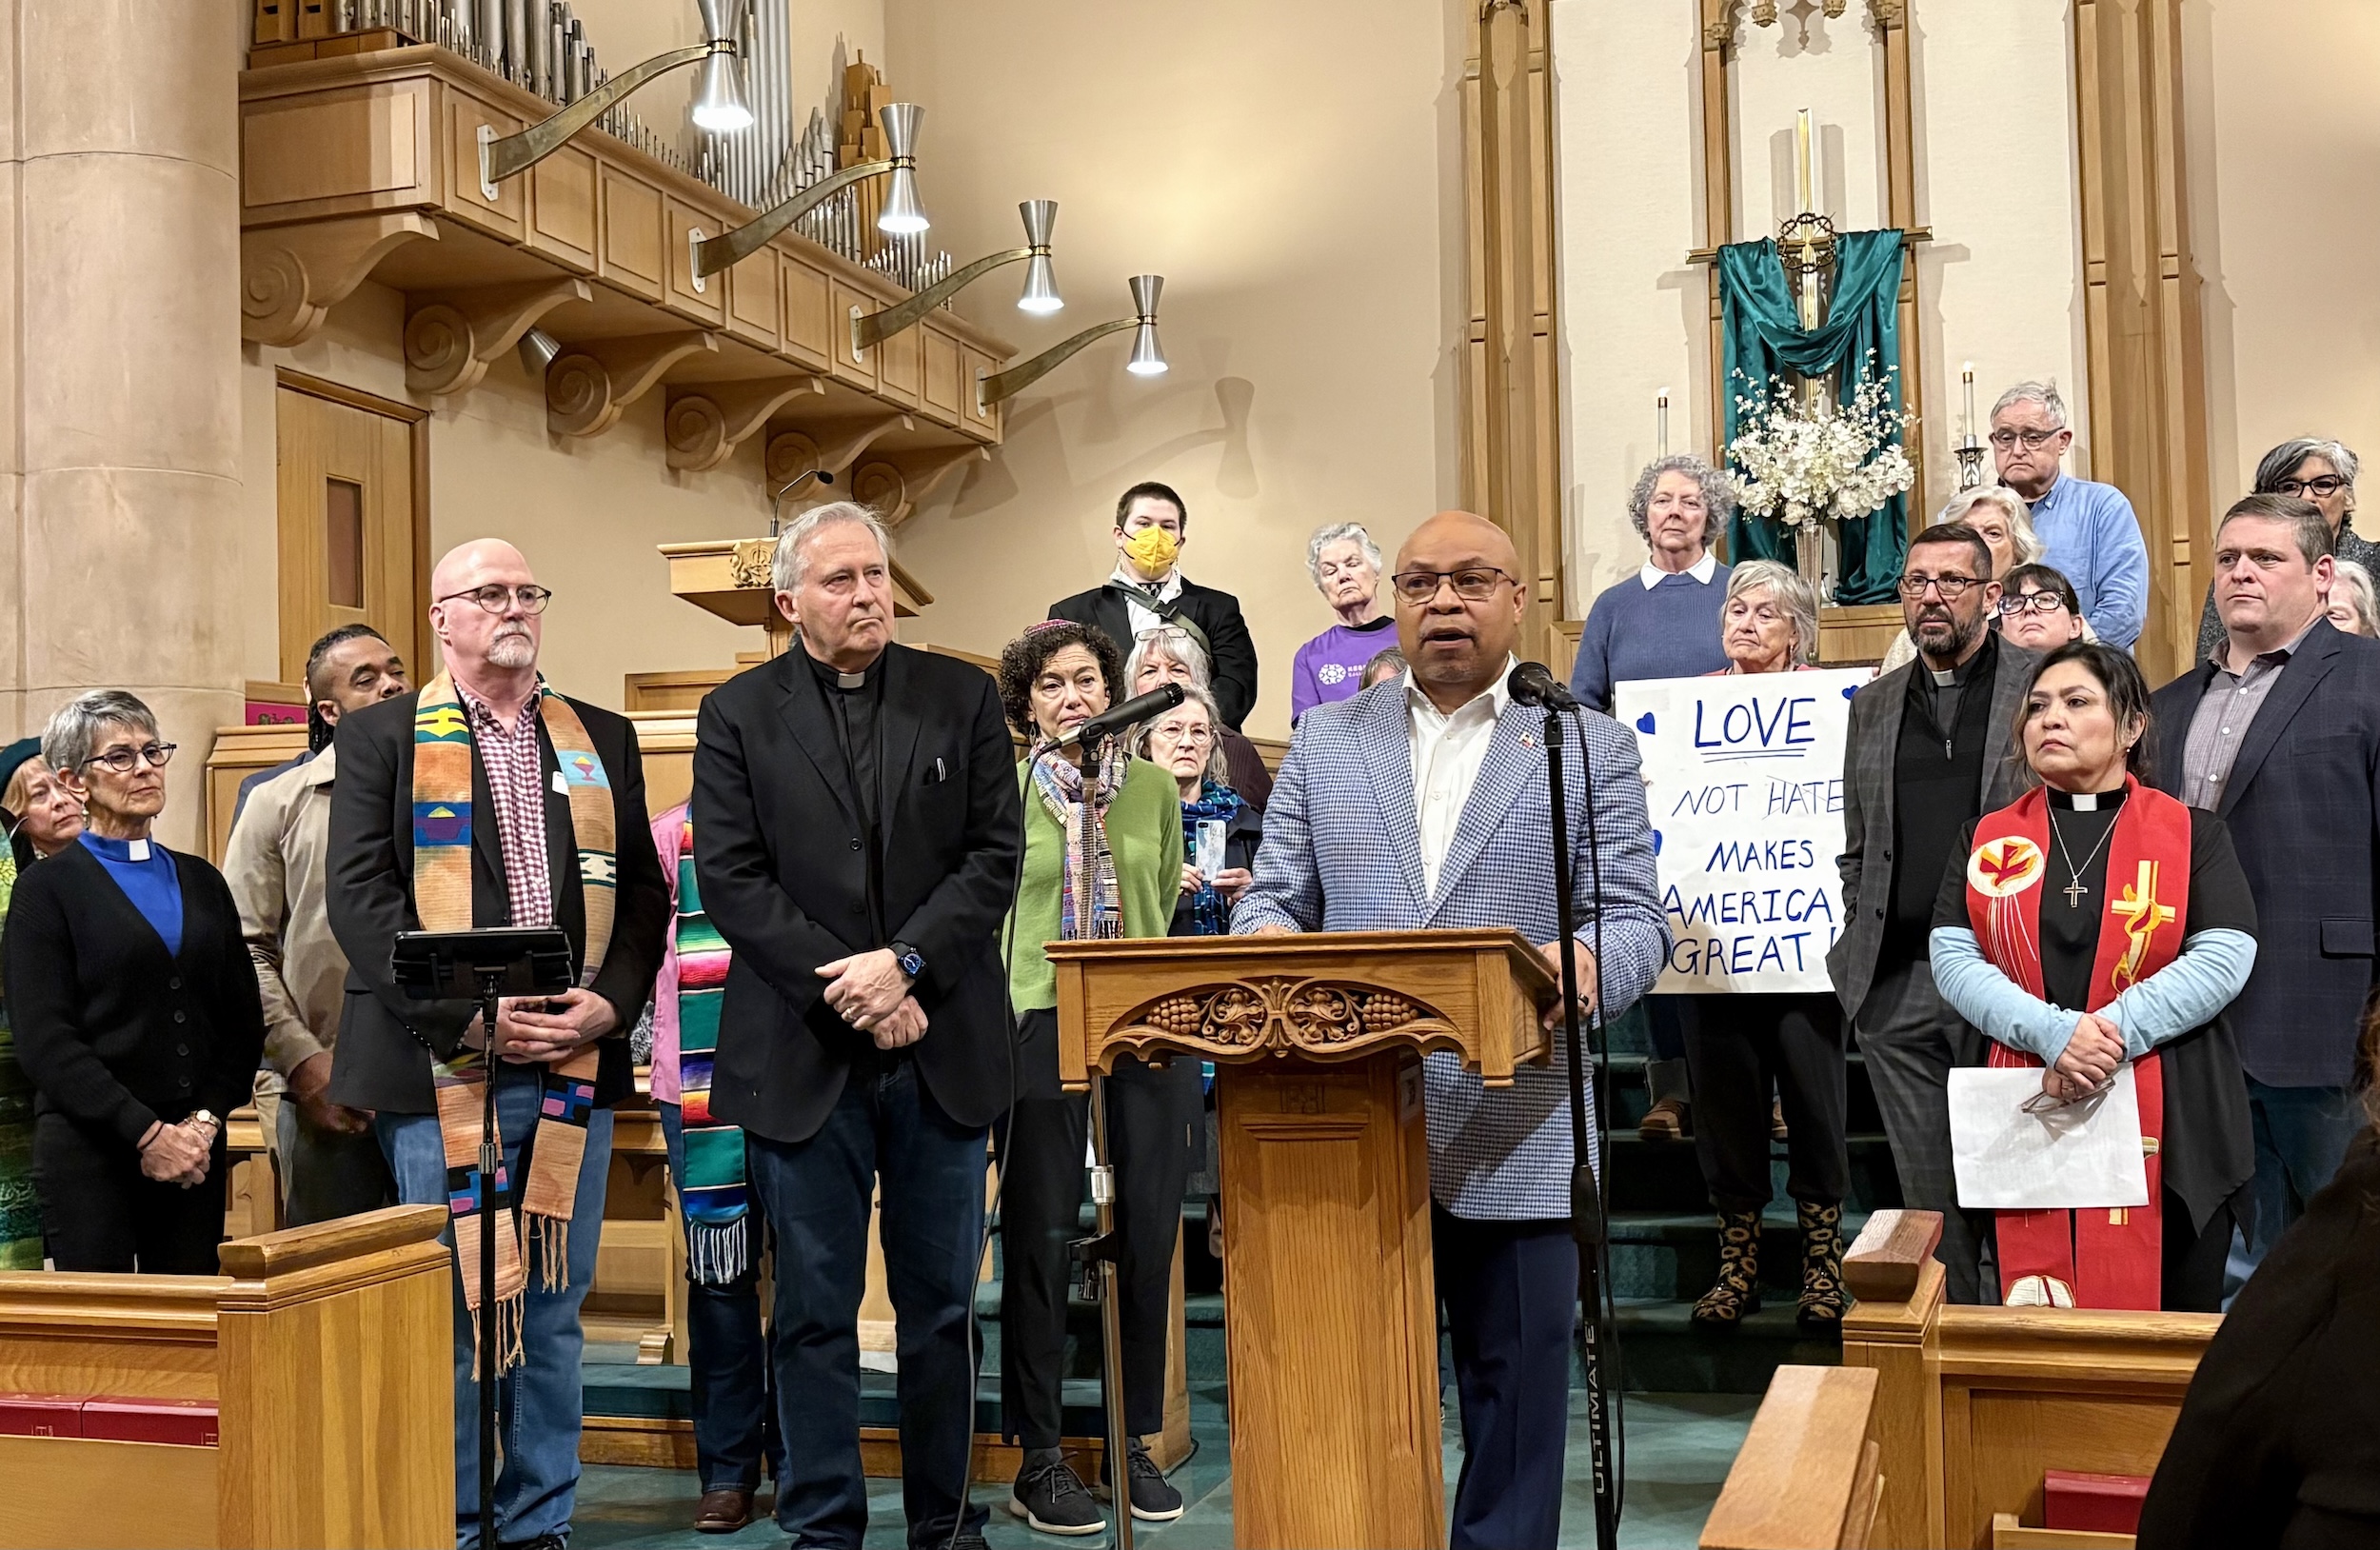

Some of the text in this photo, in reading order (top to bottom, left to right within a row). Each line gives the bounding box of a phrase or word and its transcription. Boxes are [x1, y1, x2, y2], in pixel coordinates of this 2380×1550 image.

[1695, 697, 1815, 747] LOVE
[1672, 779, 1844, 817] NOT HATE
[1705, 841, 1814, 872] MAKES
[1663, 884, 1833, 929] AMERICA
[1584, 1323, 1604, 1494] ULTIMATE
